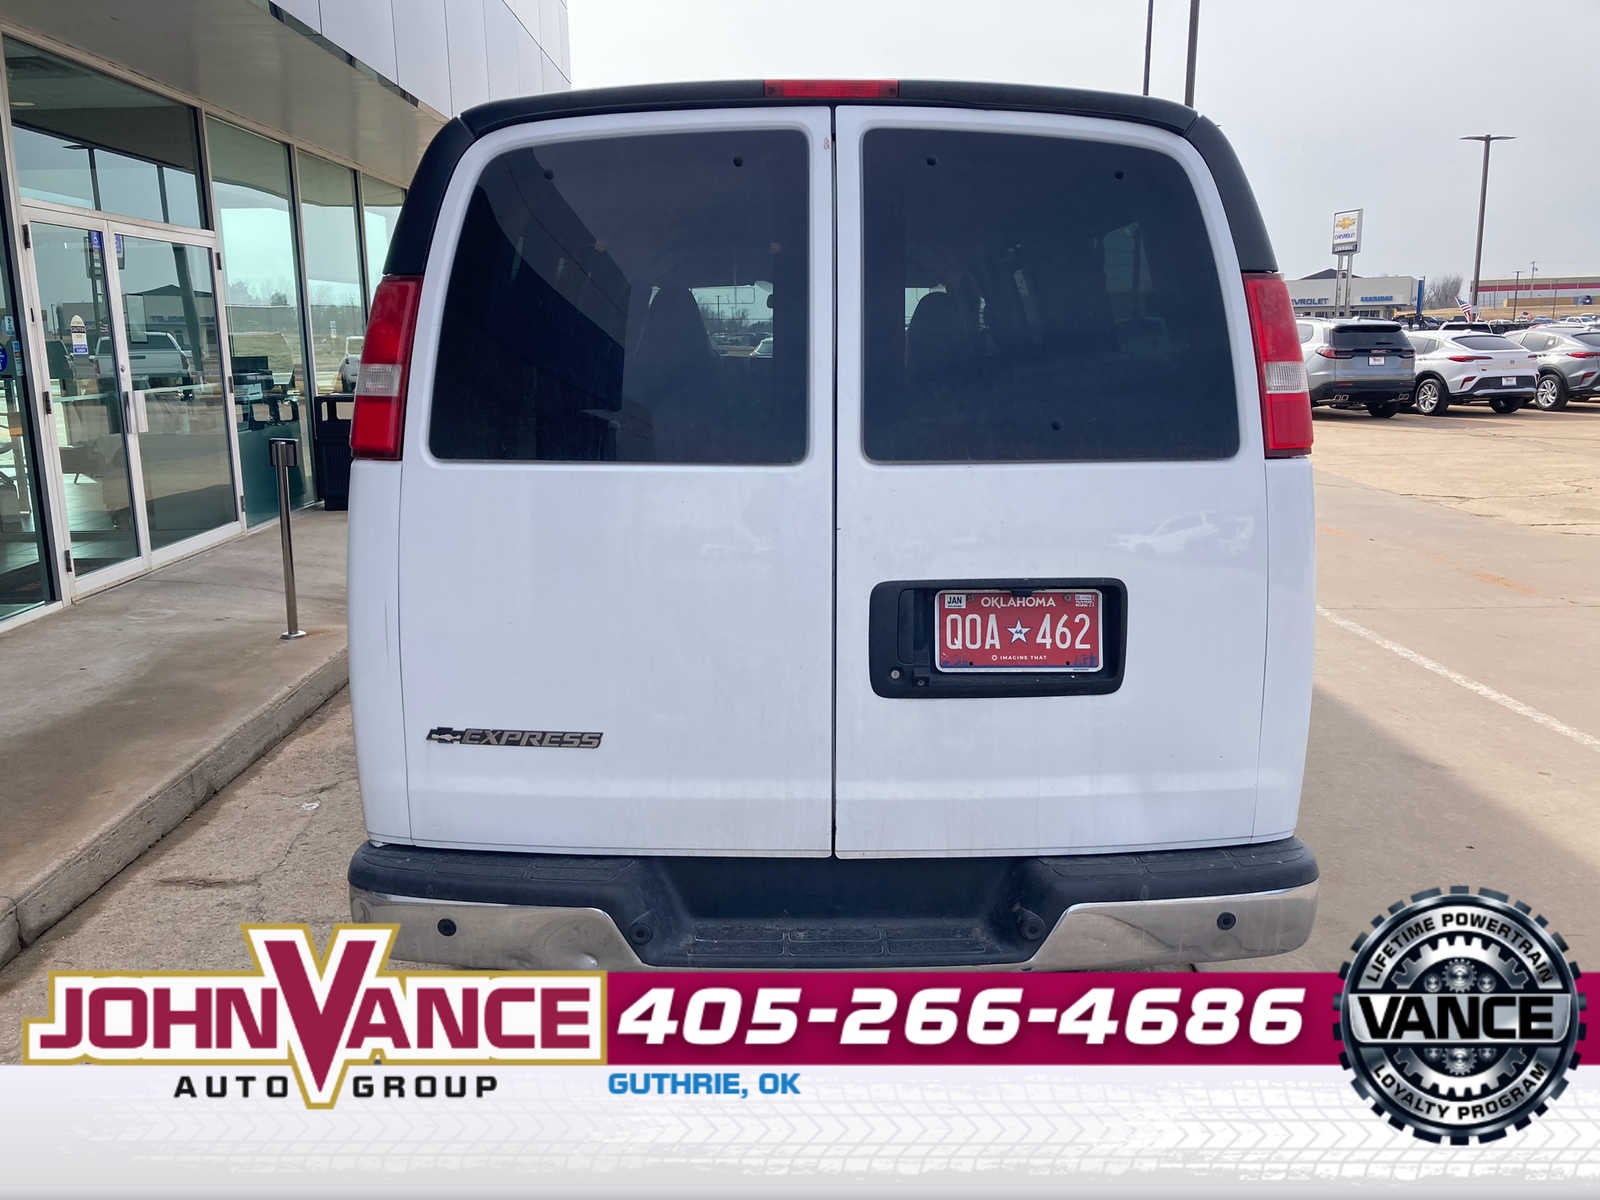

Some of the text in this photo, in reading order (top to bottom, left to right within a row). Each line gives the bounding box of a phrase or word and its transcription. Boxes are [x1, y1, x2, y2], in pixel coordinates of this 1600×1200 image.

[947, 596, 962, 604] JAN
[981, 597, 1056, 608] OKLAHOMA
[1036, 613, 1091, 649] 462
[461, 728, 603, 749] EXPRESS
